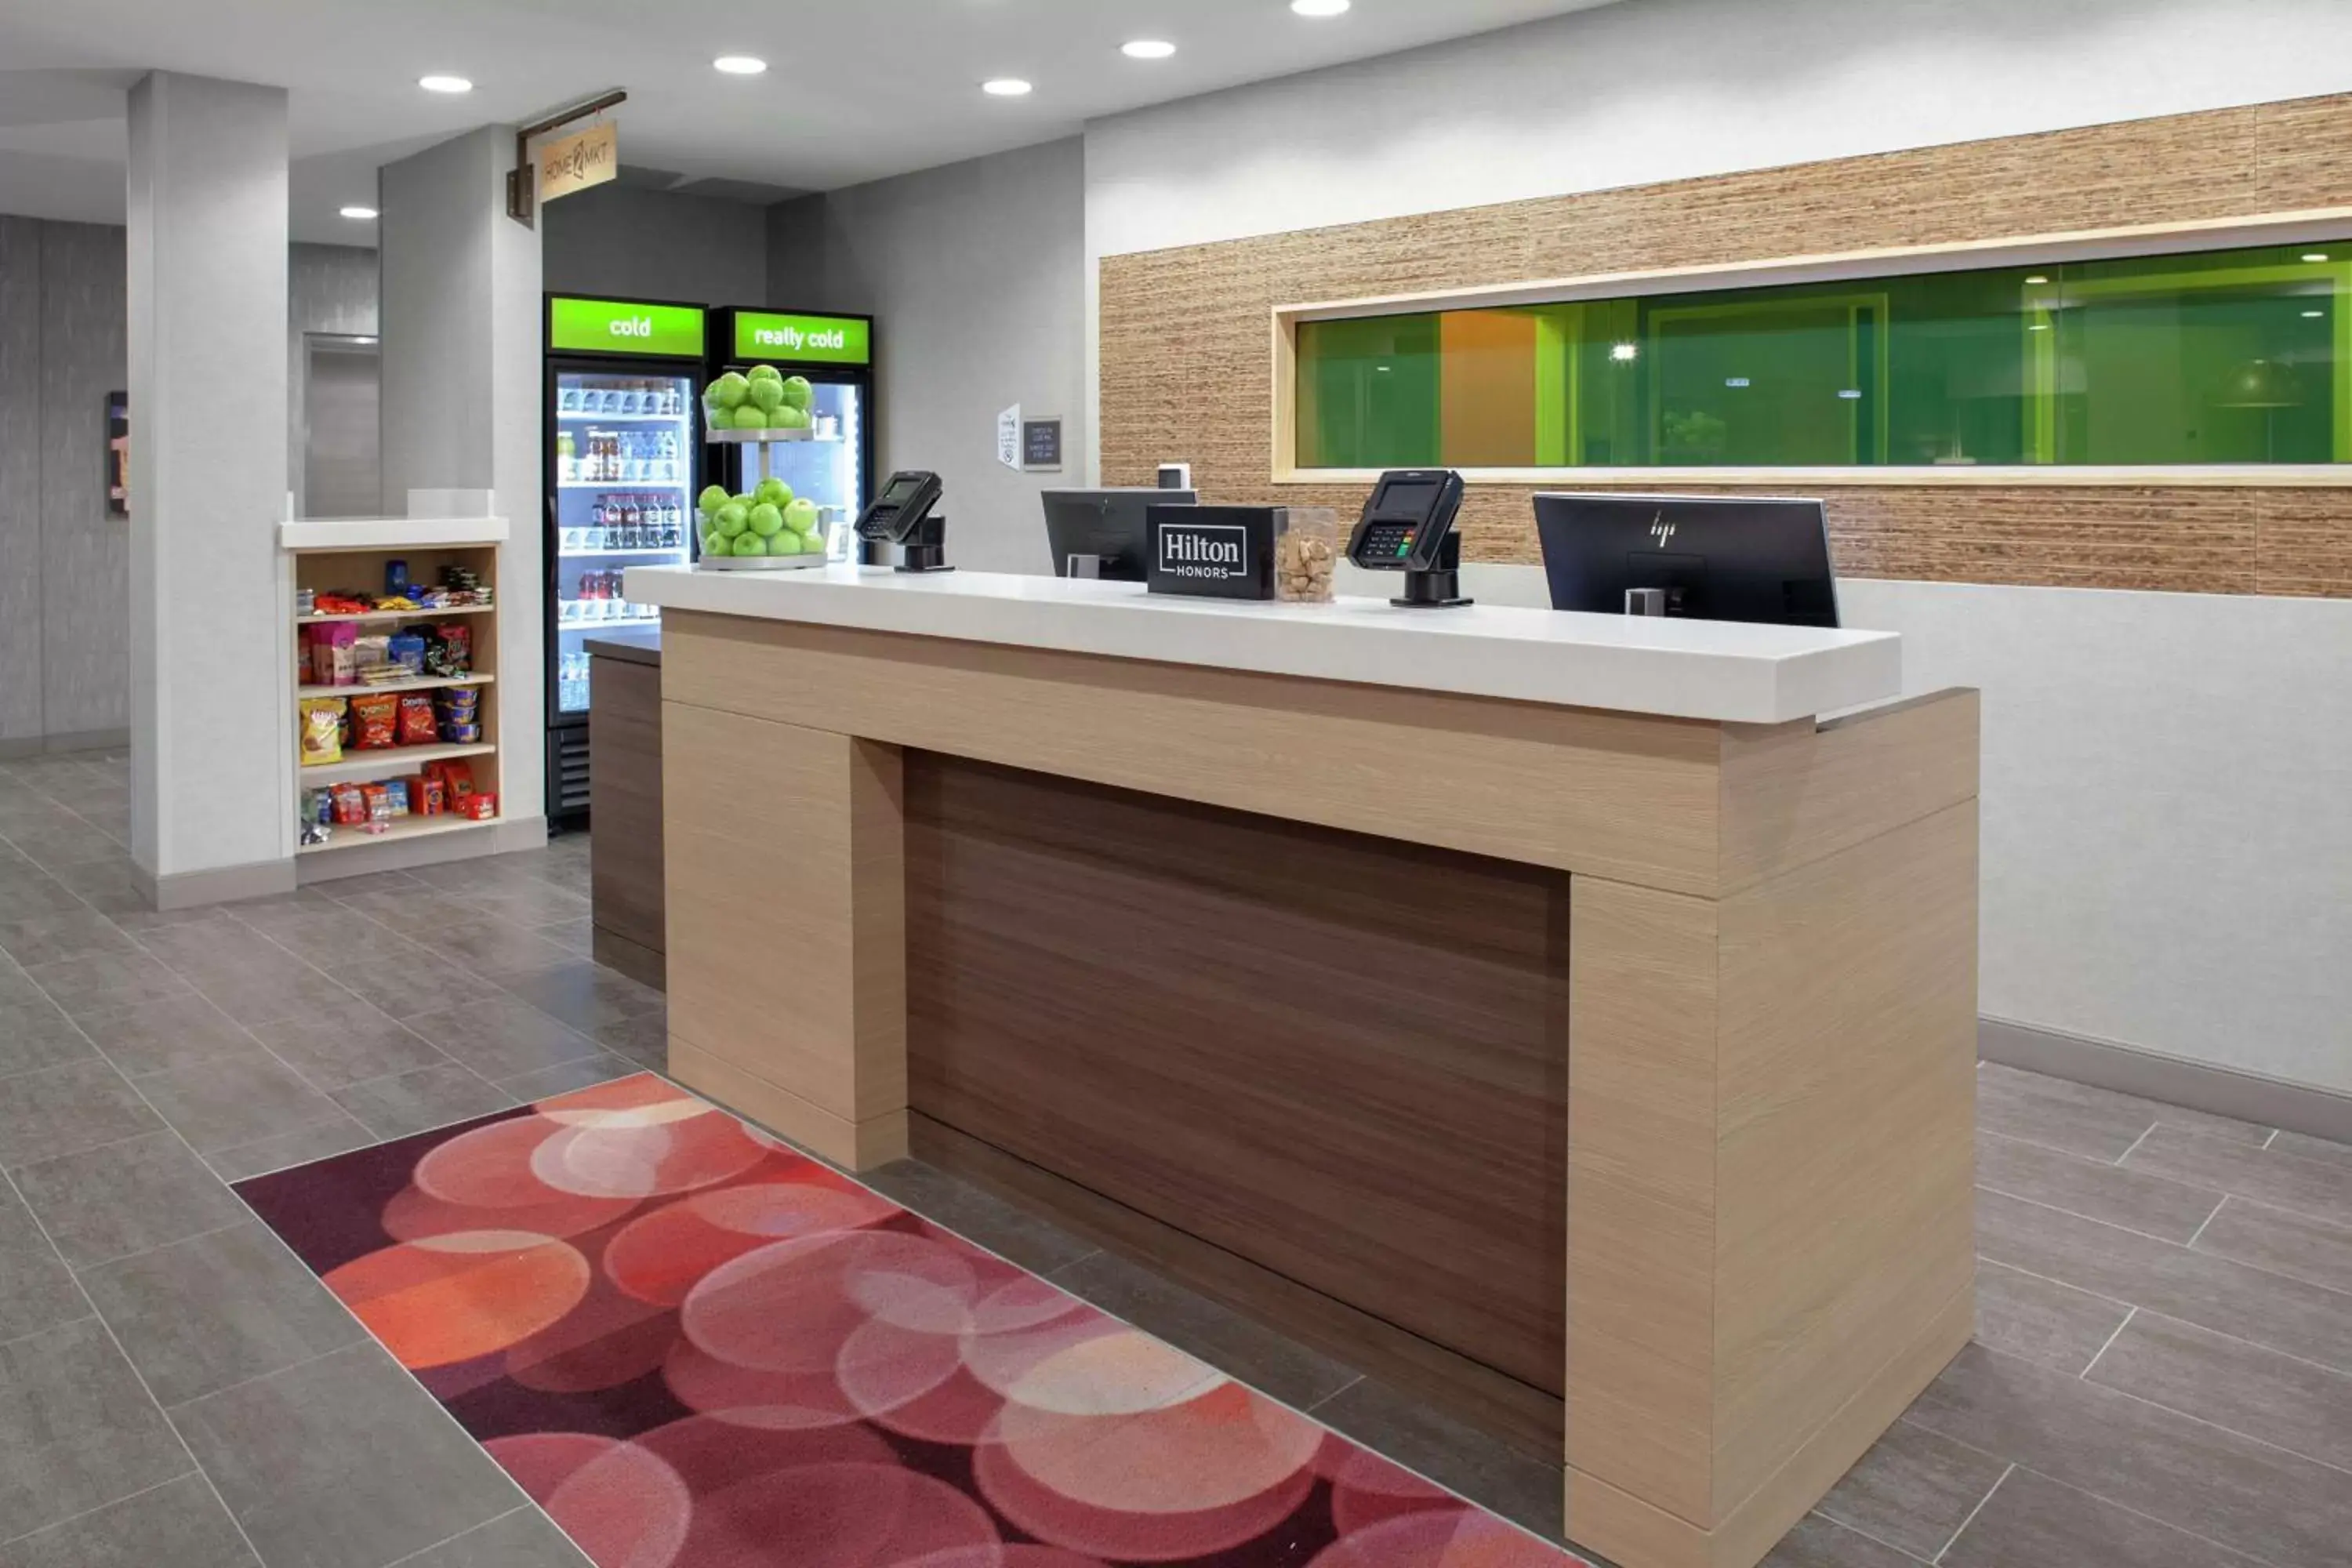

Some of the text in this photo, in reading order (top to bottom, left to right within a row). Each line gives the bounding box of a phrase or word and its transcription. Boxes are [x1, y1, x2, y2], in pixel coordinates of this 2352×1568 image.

[584, 141, 608, 169] MKT
[608, 317, 652, 337] cold
[754, 328, 844, 350] really cold
[1650, 510, 1676, 548] hp
[1166, 533, 1240, 563] Hilton
[1176, 564, 1229, 579] HONORS
